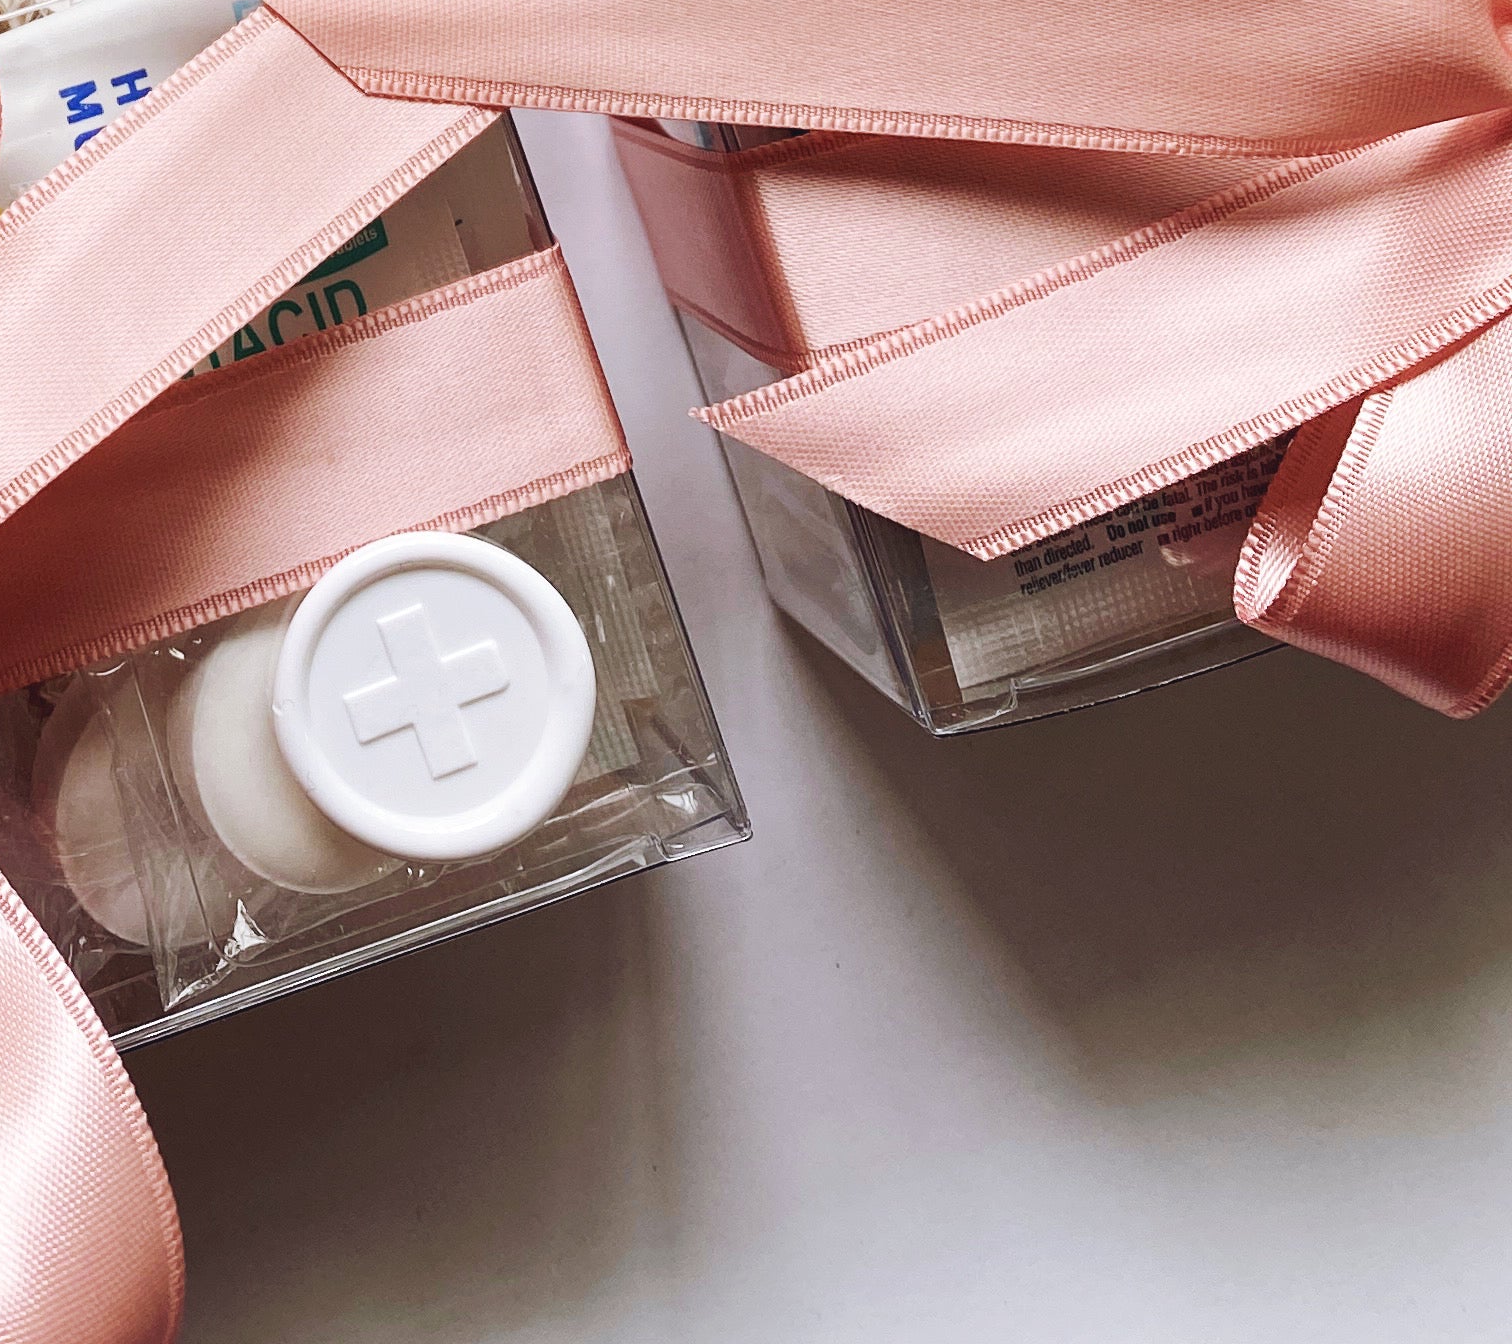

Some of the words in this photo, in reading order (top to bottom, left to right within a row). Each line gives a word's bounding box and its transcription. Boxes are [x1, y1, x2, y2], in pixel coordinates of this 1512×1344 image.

[183, 279, 368, 379] ACID
[1014, 556, 1041, 575] than
[1043, 541, 1093, 562] directed.
[1107, 523, 1125, 541] Do
[1127, 516, 1148, 534] not
[1098, 542, 1144, 566] reducer
